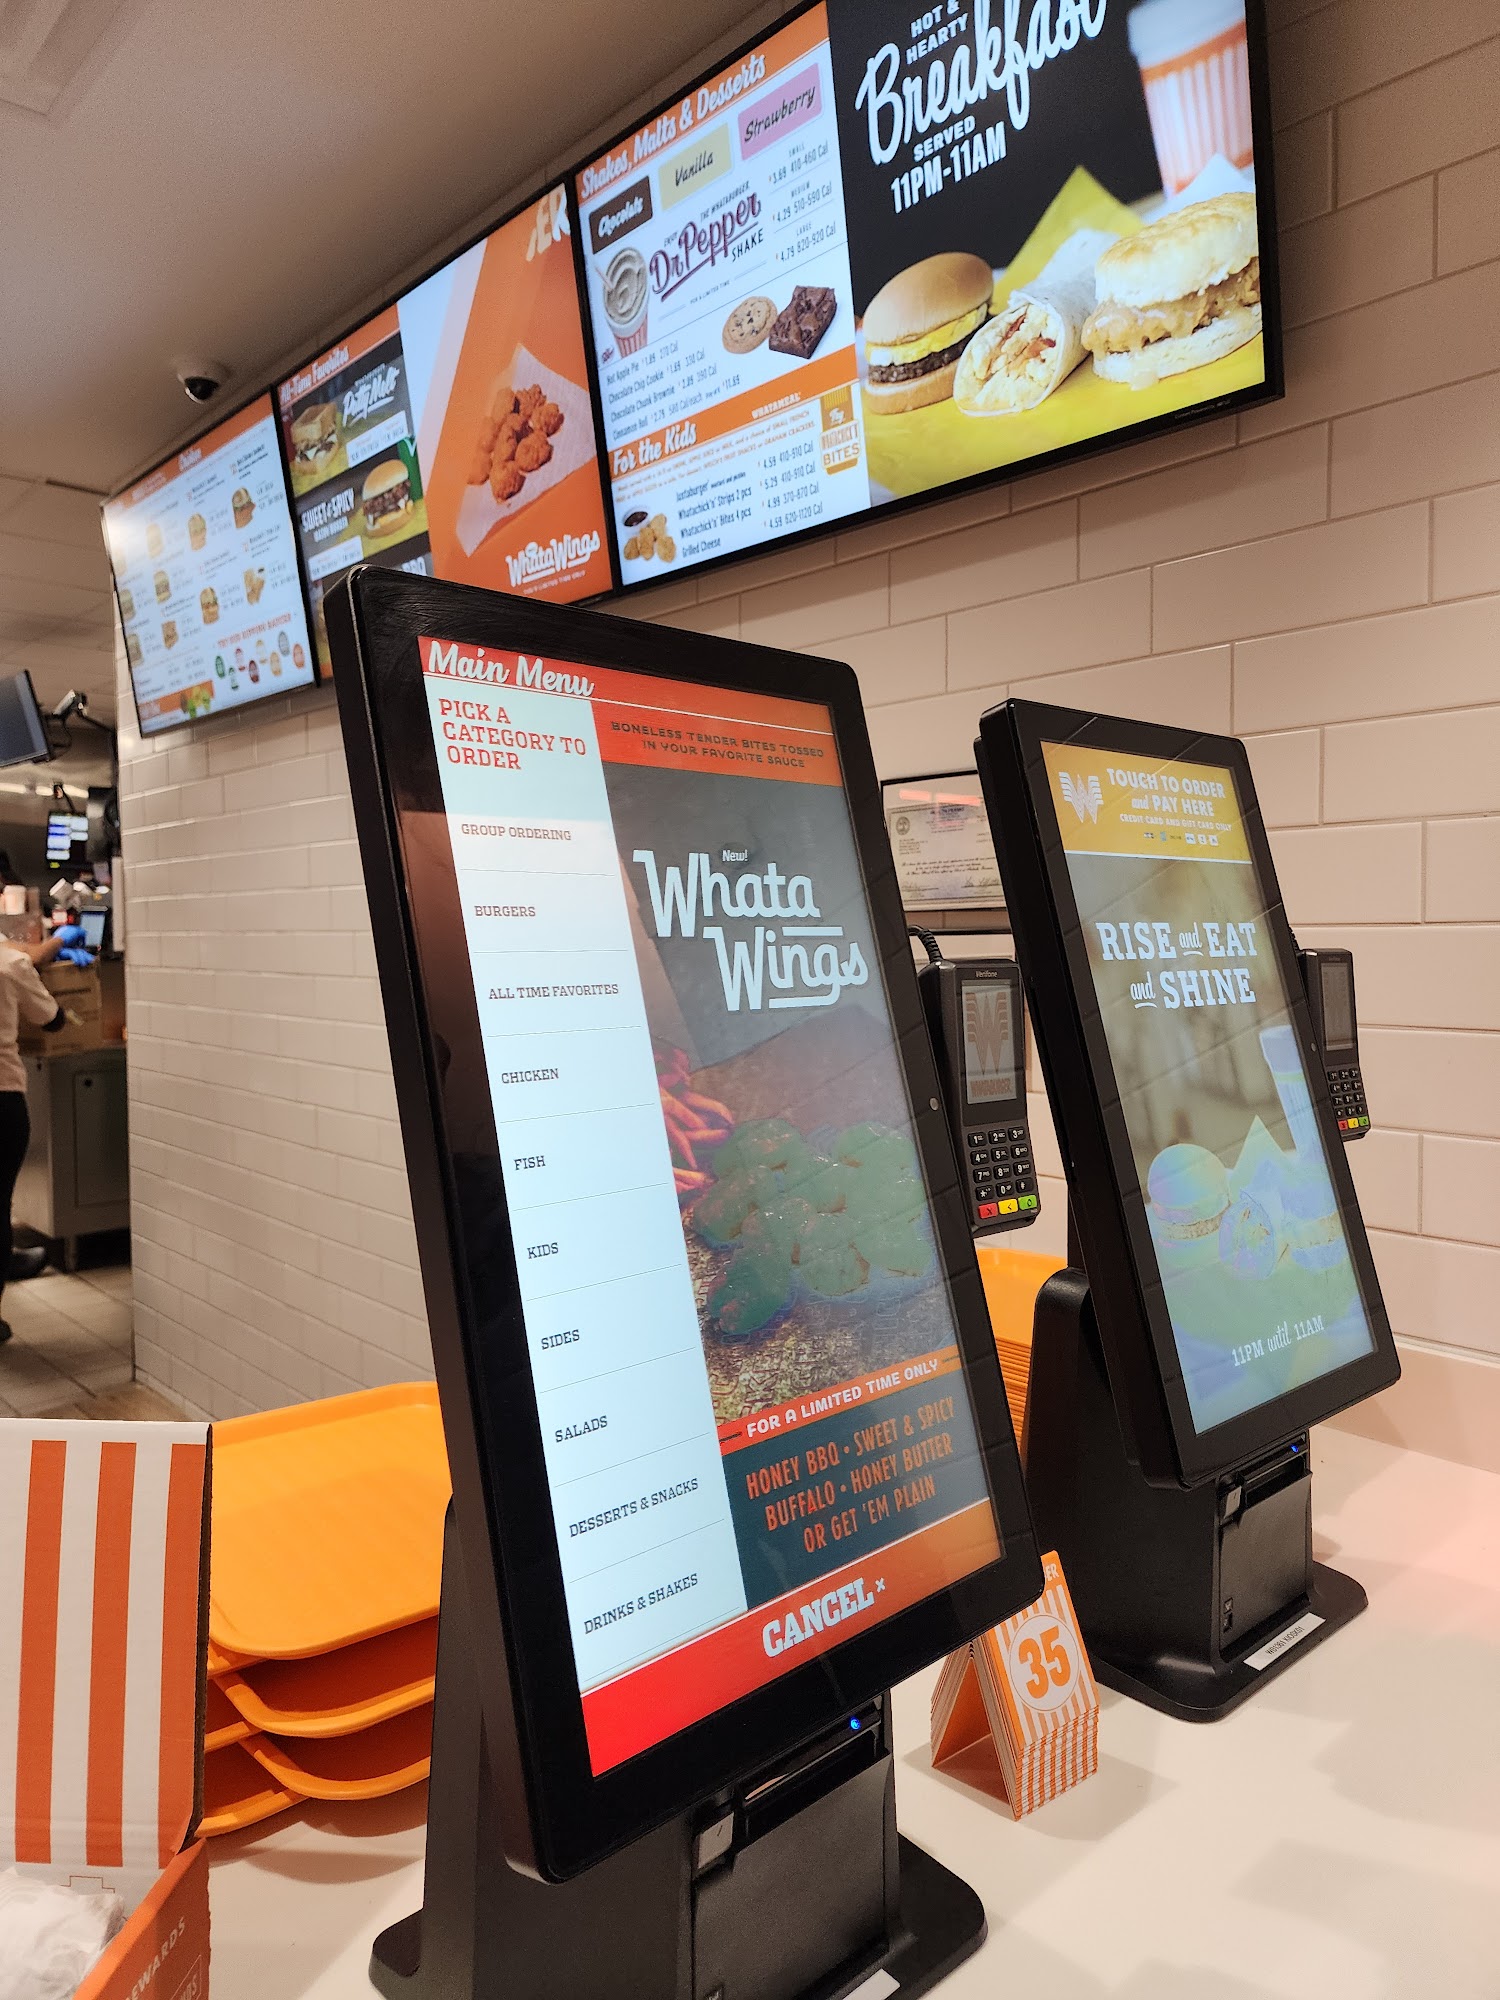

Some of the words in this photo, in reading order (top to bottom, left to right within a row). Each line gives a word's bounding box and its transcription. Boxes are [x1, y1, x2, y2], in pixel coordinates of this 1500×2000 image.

[911, 4, 943, 38] HOT
[946, 0, 960, 15] &
[905, 12, 969, 65] HEARTY
[855, 0, 1106, 165] Breakfast
[634, 115, 677, 163] Malts
[680, 98, 694, 131] &
[696, 54, 766, 120] Desserts
[744, 86, 816, 142] Strawberry
[817, 138, 828, 158] Cal
[913, 115, 976, 162] SERVED
[675, 150, 714, 187] Vanilla
[891, 121, 1007, 214] 11PM-11AM
[821, 180, 832, 199] Cal
[649, 249, 684, 295] Dr
[678, 192, 762, 270] Pepper
[732, 228, 764, 262] SHAKE
[824, 219, 836, 238] Cal
[613, 449, 636, 476] For
[638, 438, 662, 465] the
[664, 420, 697, 455] Kids
[803, 439, 813, 454] Cal
[823, 442, 860, 466] BITES
[805, 460, 815, 475] Cal
[740, 486, 752, 501] pcs
[809, 480, 819, 495] Cal
[740, 507, 751, 521] pcs
[812, 500, 823, 515] Cal
[428, 640, 510, 683] Main
[515, 655, 595, 697] Menu
[438, 698, 492, 723] PICK
[496, 706, 511, 725] A
[443, 721, 555, 752] CATEGORY
[560, 736, 587, 756] TO
[610, 720, 683, 740] BONELESS
[687, 731, 738, 748] TENDER
[741, 739, 776, 752] BITES
[779, 744, 824, 758] TOSSED
[642, 739, 657, 751] IN
[660, 741, 698, 755] YOUR
[701, 747, 764, 763] FAVORITE
[767, 755, 805, 768] SAUCE
[447, 745, 521, 770] ORDER
[1106, 768, 1159, 791] TOUCH
[1160, 775, 1180, 793] TO
[1182, 777, 1226, 799] ORDER
[1119, 813, 1144, 823] CREDIT
[1146, 816, 1163, 826] CARD
[1165, 818, 1181, 827] AND
[1181, 819, 1196, 829] GIFT
[1197, 820, 1214, 831] CARD
[1215, 823, 1232, 832] ONLY
[1131, 795, 1149, 810] and
[1152, 795, 1178, 813] PAY
[1181, 798, 1215, 817] HERE
[461, 823, 506, 837] GROUP
[509, 826, 572, 841] ORDERING
[722, 849, 749, 862] New!
[474, 904, 537, 918] BURGERS
[632, 849, 821, 938] Whata
[1096, 922, 1177, 961] RISE
[1179, 922, 1203, 950] and
[1203, 922, 1257, 957] EAT
[702, 926, 869, 1012] Wings
[488, 987, 515, 1000] ALL
[516, 985, 551, 999] TIME
[552, 983, 619, 997] FAVORITES
[1130, 971, 1157, 1001] and
[1159, 968, 1256, 1009] SHINE
[501, 1068, 560, 1085] CHICKEN
[514, 1155, 546, 1171] FISH
[527, 1242, 559, 1260] KIDS
[540, 1329, 581, 1351] SIDES
[1232, 1340, 1264, 1367] 11PM
[1268, 1321, 1292, 1352] until
[1294, 1315, 1324, 1341] 11AM
[746, 1414, 781, 1438] FOR
[785, 1408, 797, 1424] A
[800, 1385, 863, 1420] LIMITED
[865, 1372, 901, 1394] TIME
[903, 1358, 939, 1381] ONLY
[554, 1415, 608, 1443] SALADS
[745, 1455, 801, 1500] HONEY
[805, 1441, 841, 1476] BBQ
[853, 1418, 898, 1457] SWEET
[903, 1414, 914, 1437] &
[917, 1396, 955, 1431] SPICY
[764, 1480, 837, 1531] BUFFALO
[850, 1453, 898, 1495] HONEY
[902, 1432, 954, 1472] BUTTER
[568, 1500, 638, 1539] DESSERTS
[640, 1497, 650, 1511] &
[650, 1477, 699, 1507] SNACKS
[803, 1522, 828, 1554] OR
[830, 1507, 859, 1541] GET
[894, 1474, 936, 1513] PLAIN
[583, 1600, 635, 1635] DRINKS
[636, 1596, 647, 1611] &
[647, 1572, 699, 1606] SHAKES
[762, 1577, 875, 1659] CANCEL
[1018, 1624, 1072, 1700] 35
[125, 1916, 185, 2000] EWARDS
